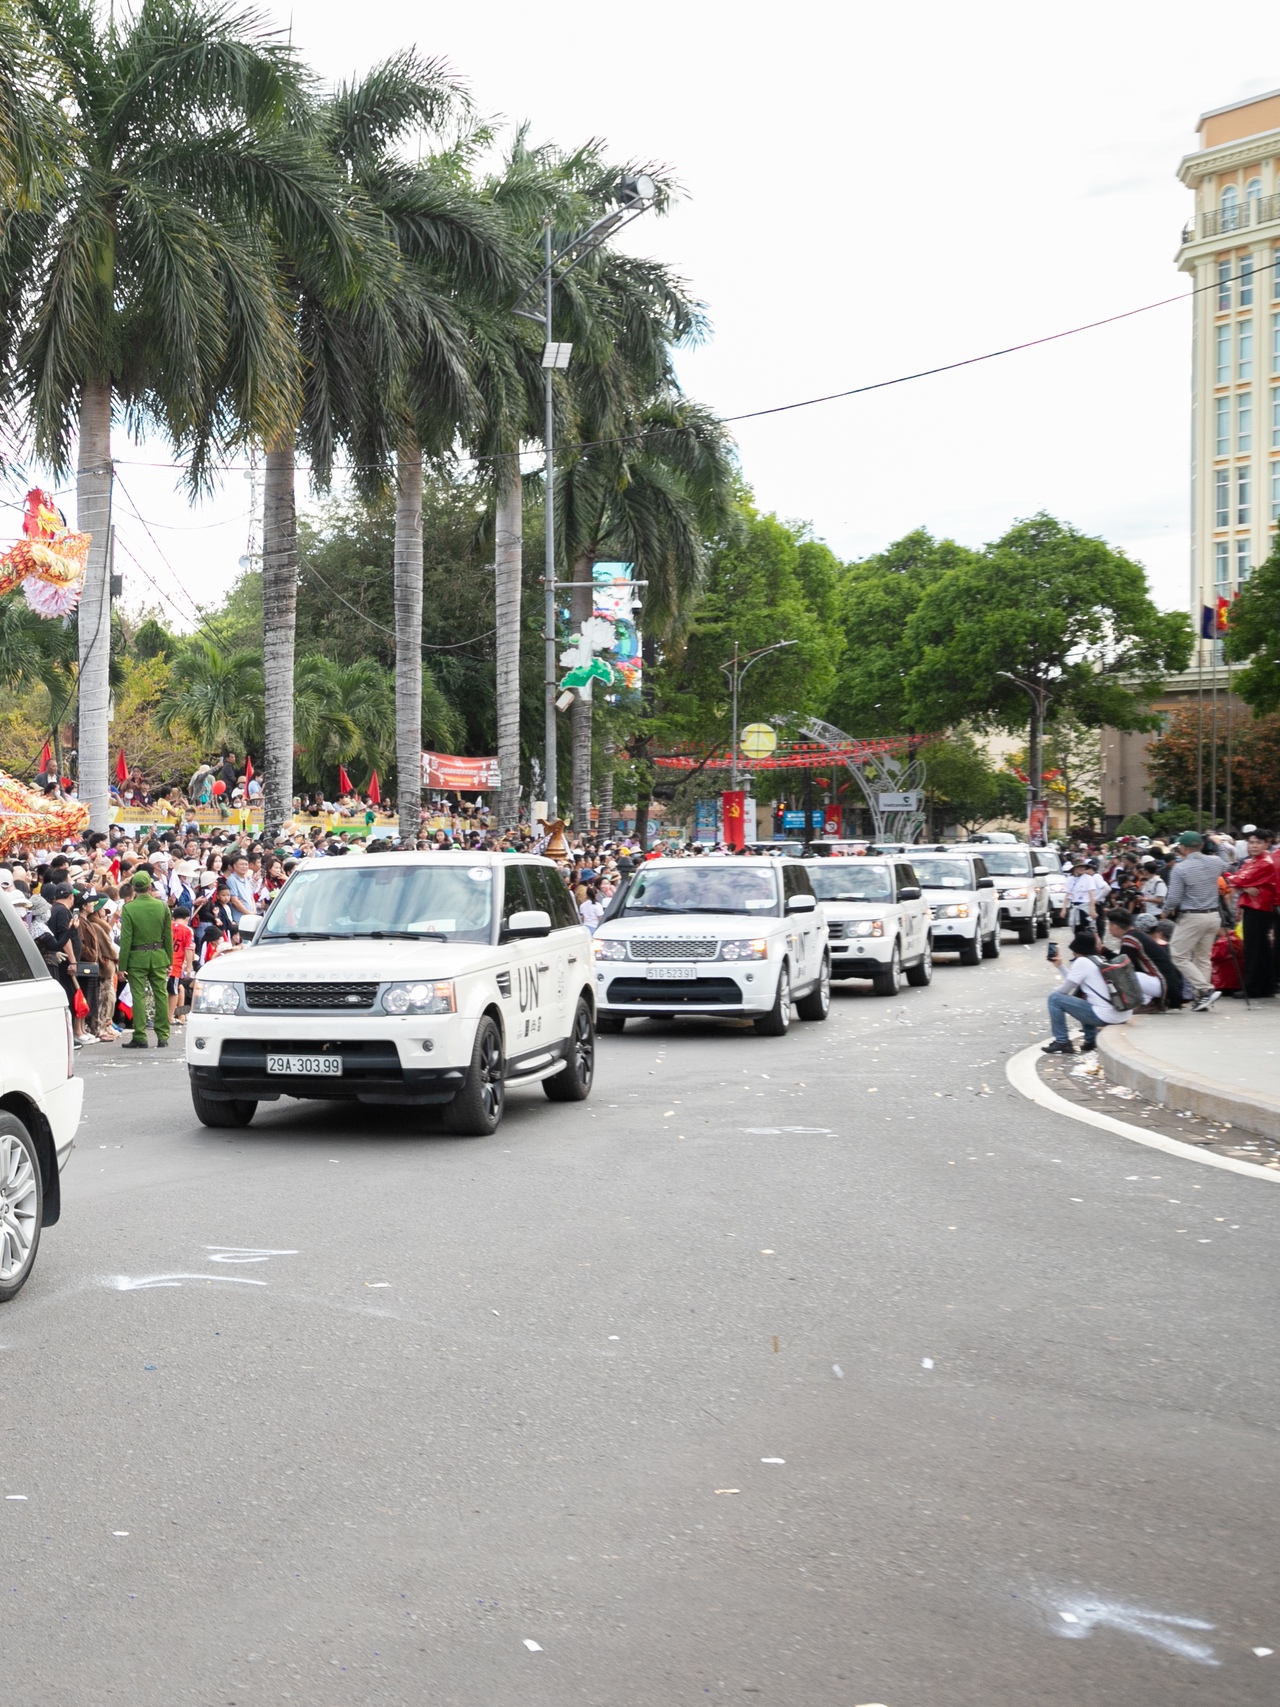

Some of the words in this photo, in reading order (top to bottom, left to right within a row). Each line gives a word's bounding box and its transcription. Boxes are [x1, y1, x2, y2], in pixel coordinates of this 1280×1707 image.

[476, 870, 483, 878] 7
[518, 963, 539, 1013] UN
[269, 1057, 339, 1073] 29A-303.99
